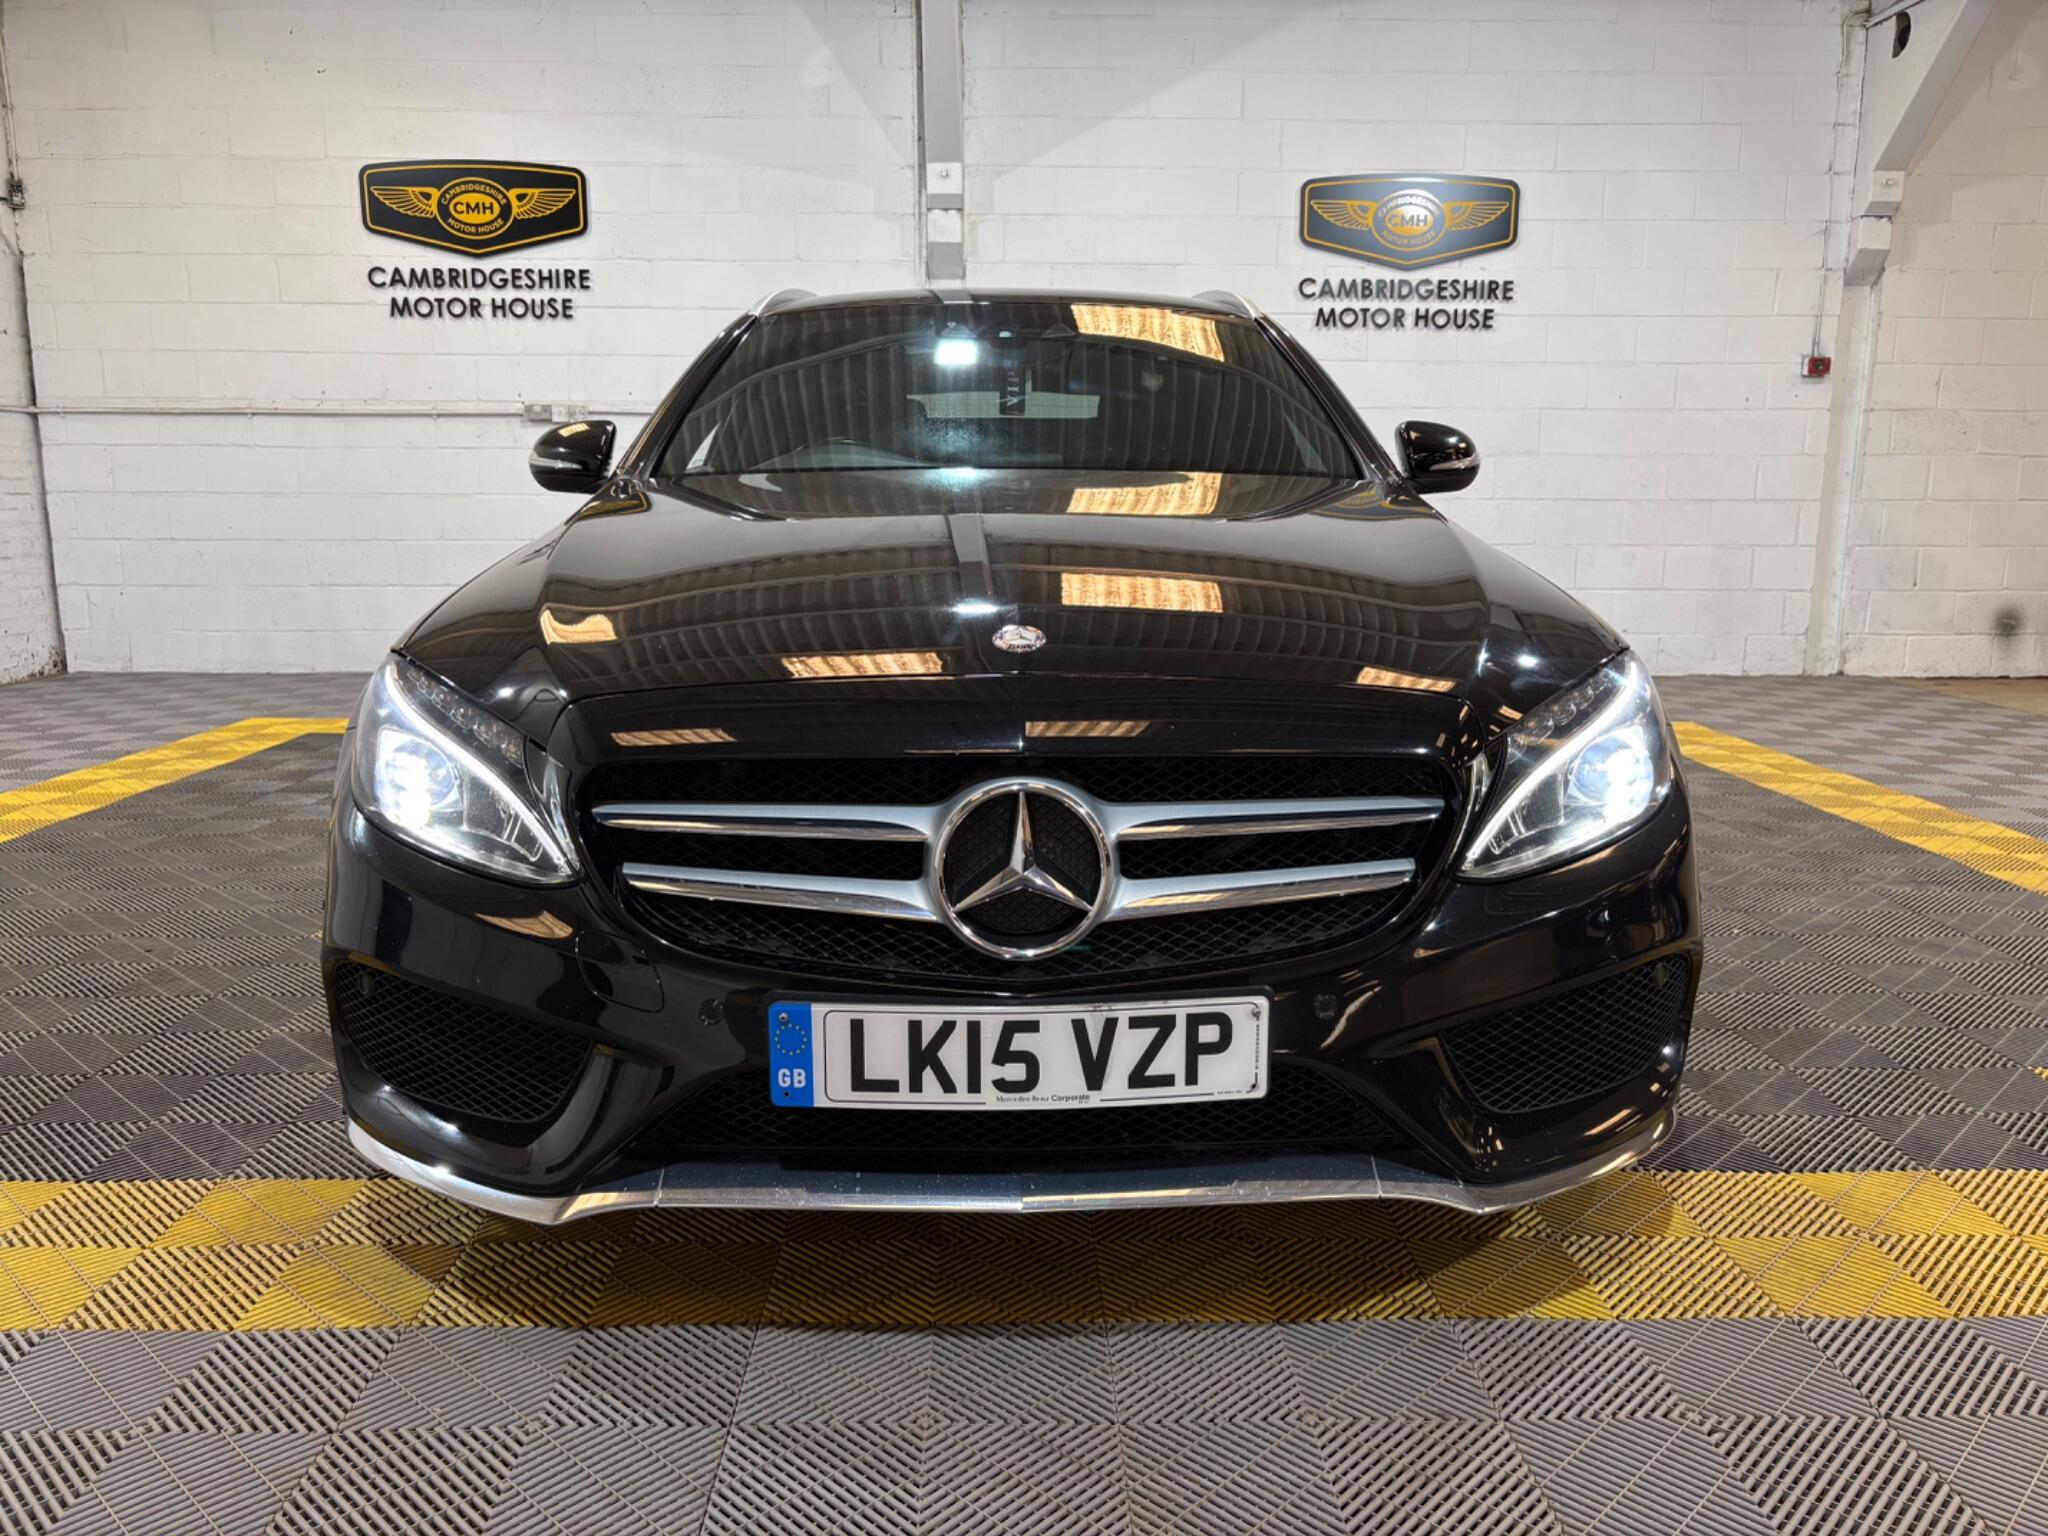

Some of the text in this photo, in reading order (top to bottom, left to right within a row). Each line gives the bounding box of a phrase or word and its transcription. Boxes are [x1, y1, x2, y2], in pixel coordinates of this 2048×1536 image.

[441, 183, 507, 205] CAMBRIDGESHIRE
[453, 201, 494, 215] CMH
[447, 217, 504, 233] MOTOR HOUSE
[1389, 214, 1428, 227] CMH
[367, 266, 591, 290] CAMBRIDGESHIRE
[1298, 277, 1514, 301] CAMBRIDGESHIRE
[390, 296, 574, 319] MOTOR HOUSE
[1315, 307, 1495, 330] MOTOR HOUSE
[849, 1017, 1041, 1095] LK15
[1071, 1011, 1233, 1092] VZP
[777, 1068, 807, 1089] GB
[1051, 1093, 1090, 1102] Corporate
